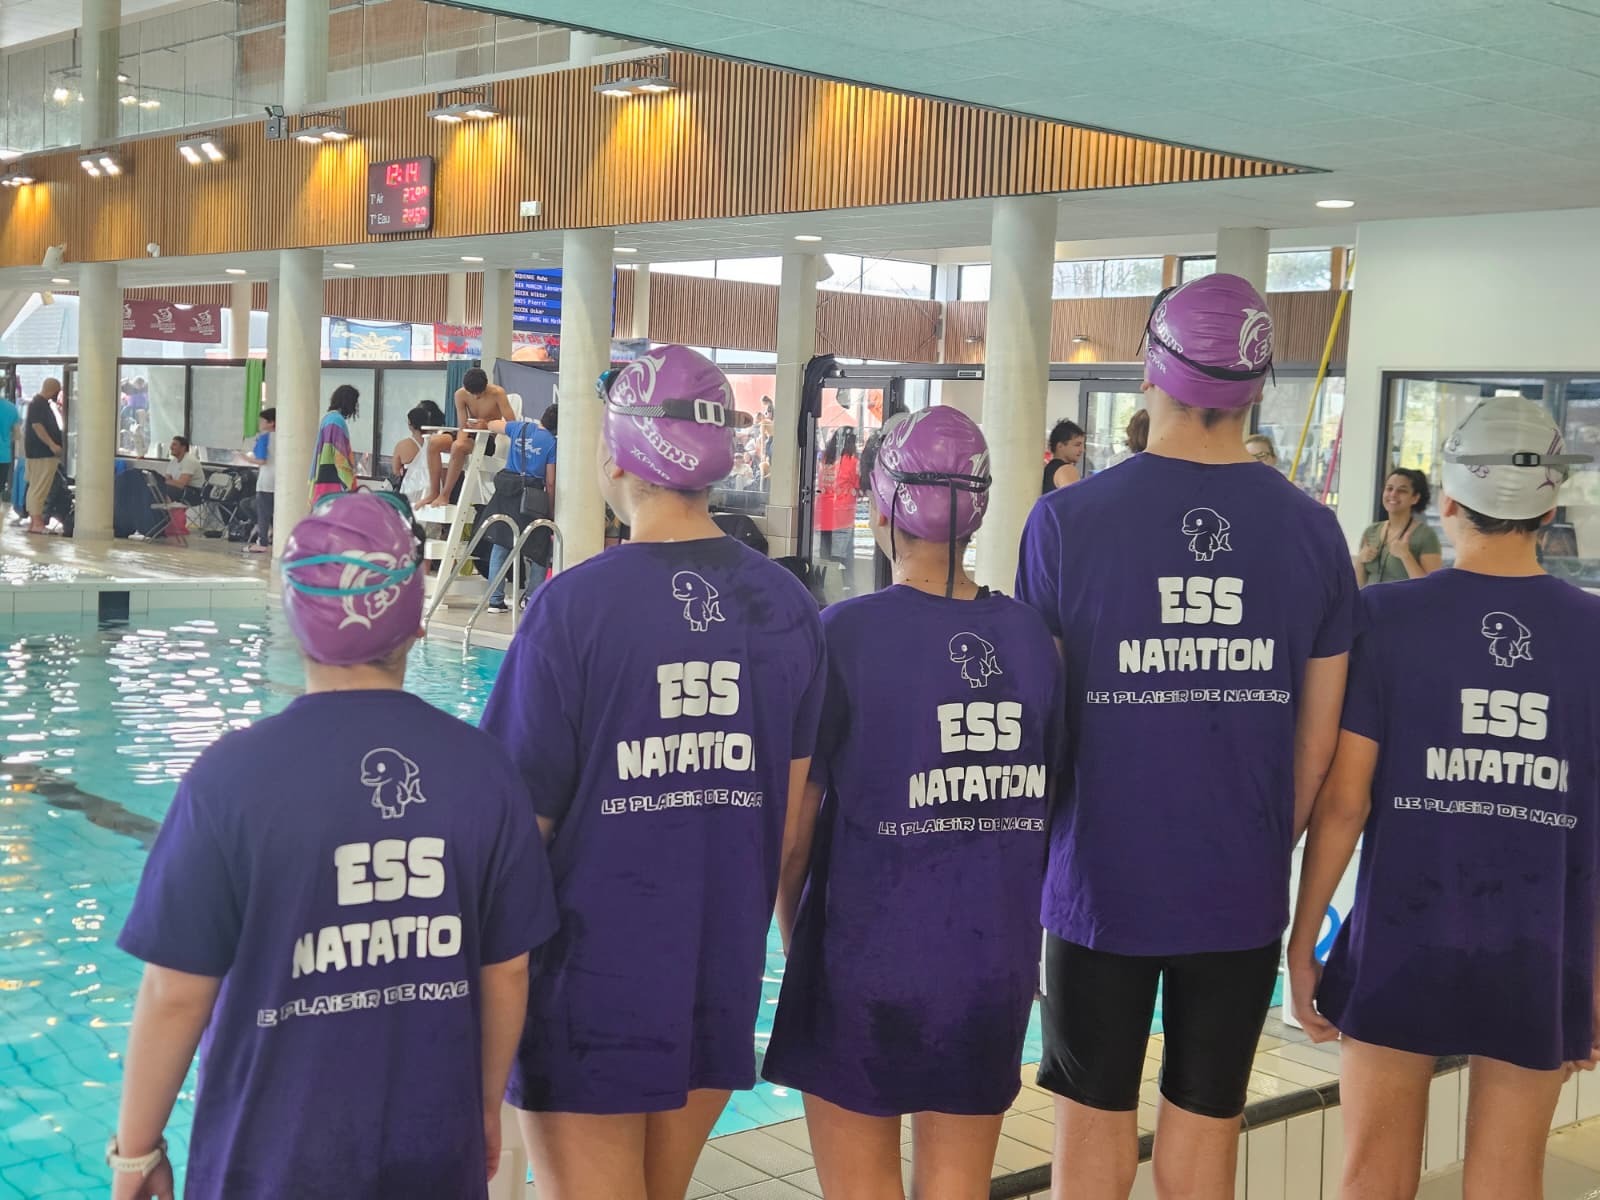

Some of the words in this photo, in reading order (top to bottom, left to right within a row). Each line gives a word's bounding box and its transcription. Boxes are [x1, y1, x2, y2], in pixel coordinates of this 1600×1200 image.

[386, 162, 419, 185] 12:14
[377, 213, 391, 225] Eau
[1158, 576, 1244, 625] ESS
[657, 660, 741, 719] ESS
[1087, 690, 1110, 704] LE
[1191, 688, 1221, 702] DE
[1223, 689, 1290, 704] NAGER
[1461, 688, 1549, 741] ESS
[937, 701, 1022, 753] ESS
[601, 796, 627, 815] LE
[1394, 796, 1421, 810] LE
[1497, 803, 1528, 820] DE
[878, 821, 897, 836] LE
[978, 817, 1001, 832] DE
[1001, 816, 1044, 832] NAGE
[334, 836, 445, 906] ESS
[384, 984, 416, 1005] DE
